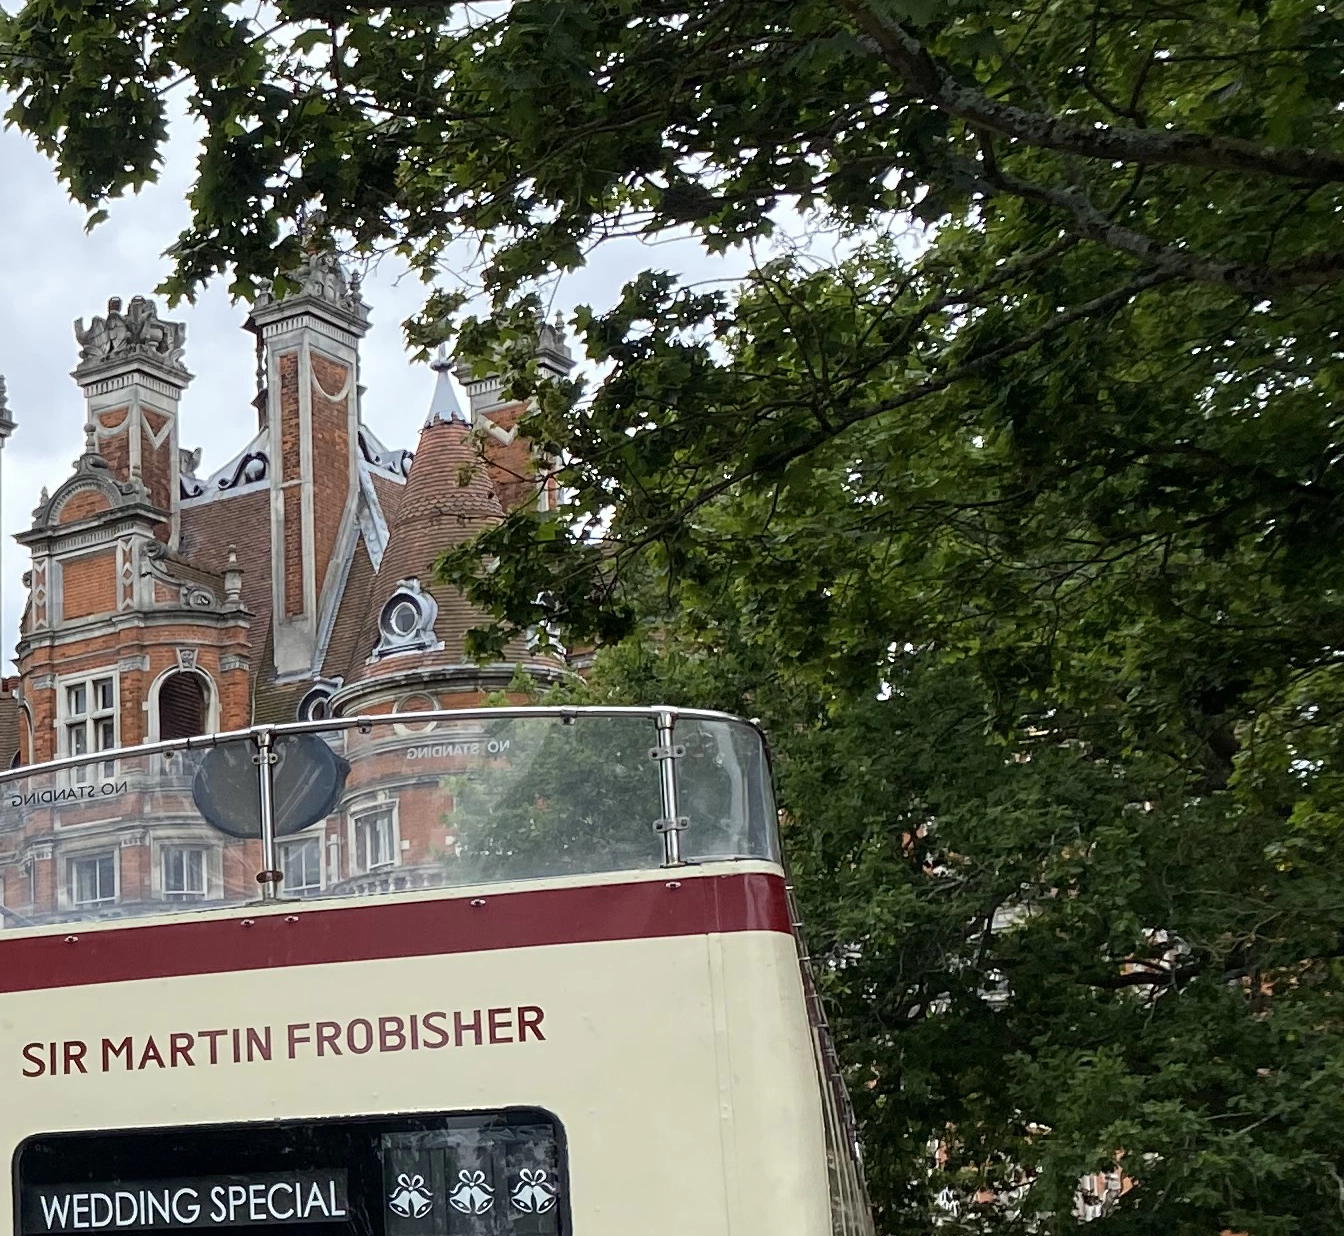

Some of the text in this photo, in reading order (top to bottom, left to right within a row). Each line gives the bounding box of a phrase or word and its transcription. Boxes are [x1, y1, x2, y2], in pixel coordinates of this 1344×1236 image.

[22, 1005, 547, 1078] SIR MARTIN FROBISHER
[40, 1180, 347, 1230] WEDDING SPECIAL
